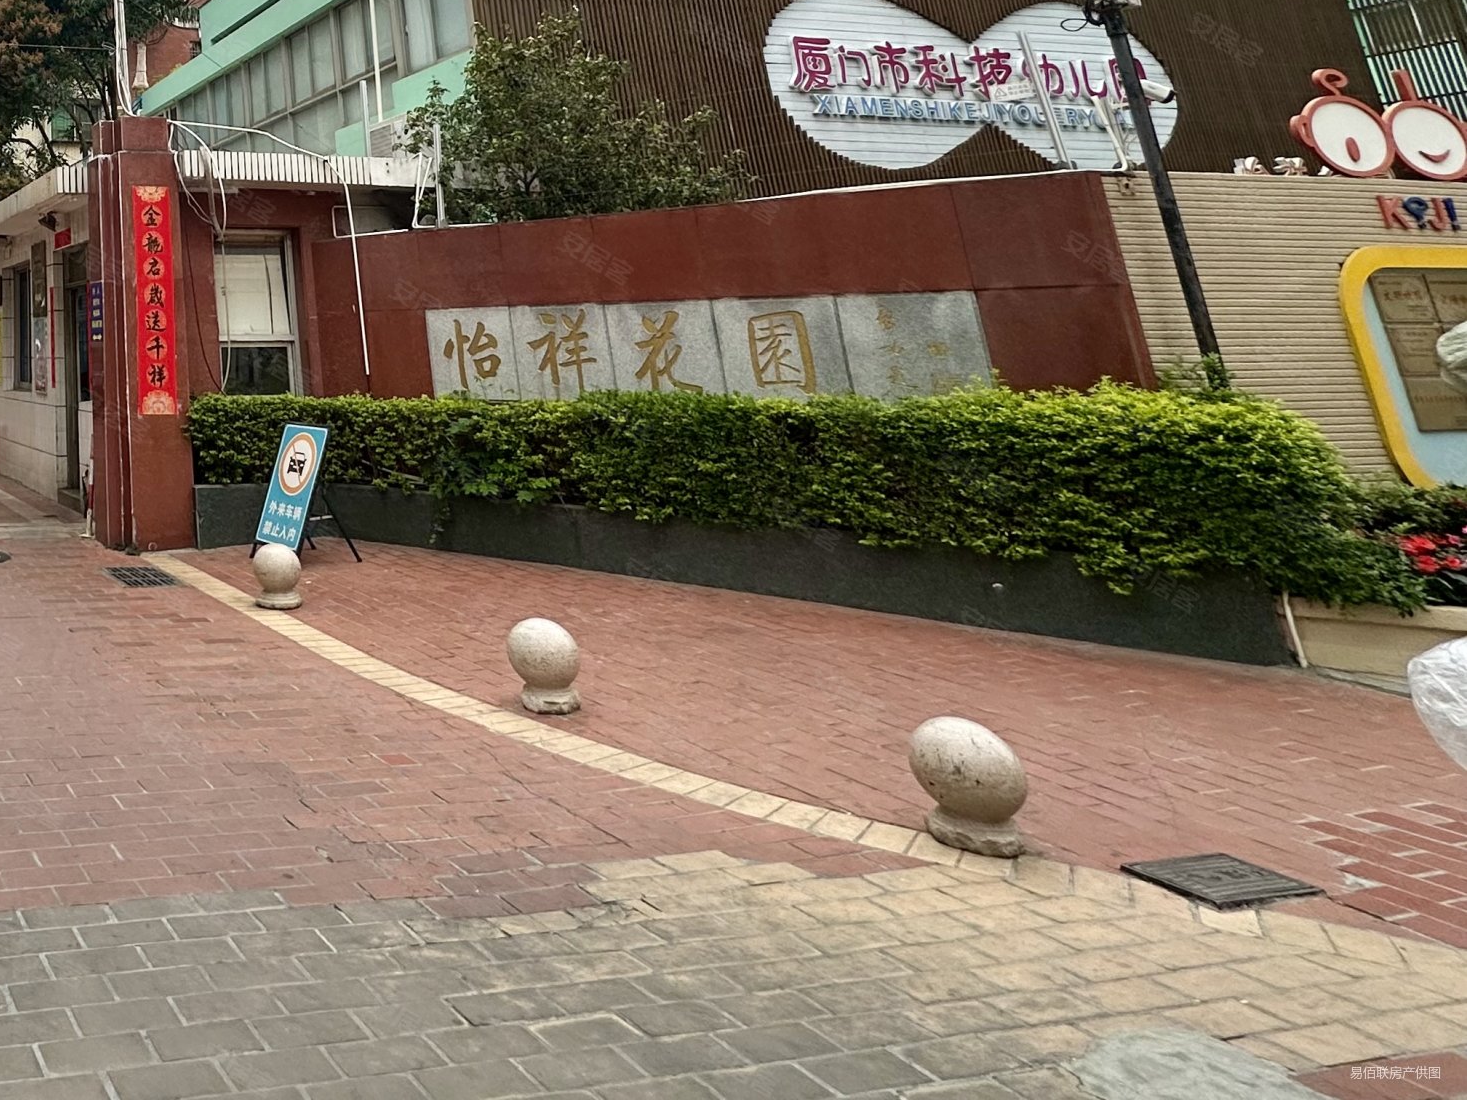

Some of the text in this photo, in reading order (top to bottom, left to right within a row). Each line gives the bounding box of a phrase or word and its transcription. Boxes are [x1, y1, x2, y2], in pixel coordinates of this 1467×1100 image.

[267, 500, 303, 522] 外来车辆
[262, 520, 297, 542] 禁止入内
